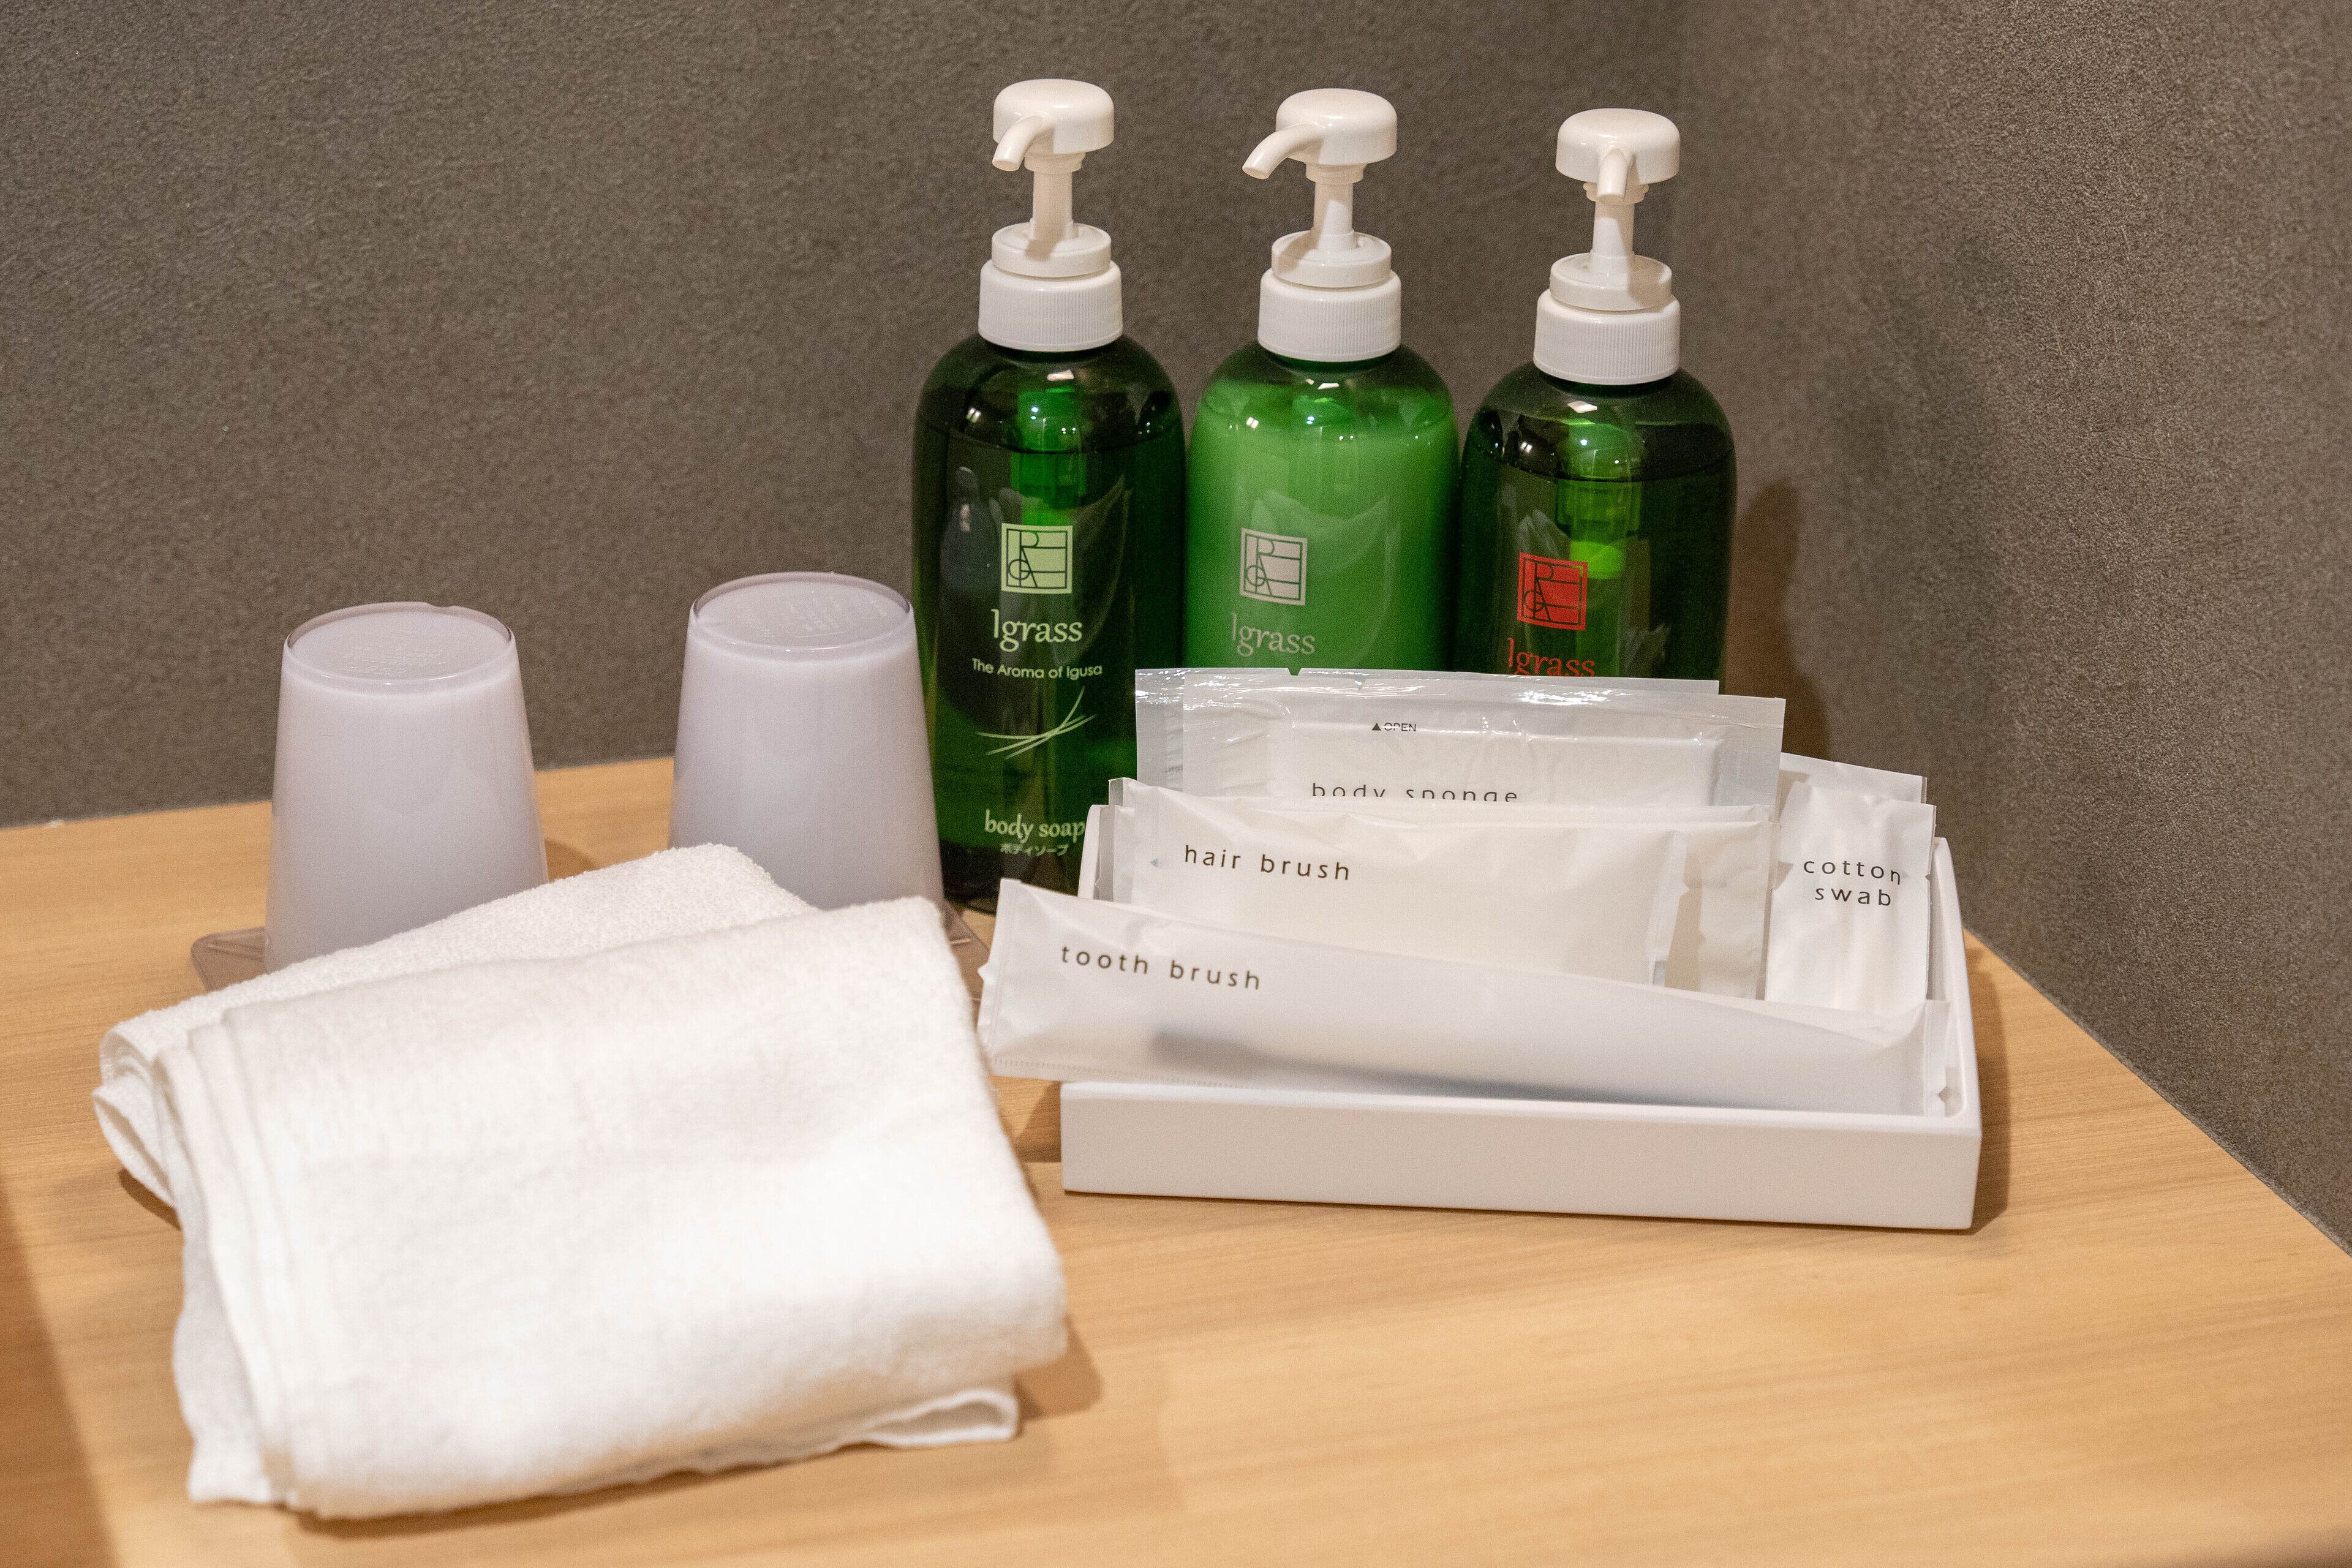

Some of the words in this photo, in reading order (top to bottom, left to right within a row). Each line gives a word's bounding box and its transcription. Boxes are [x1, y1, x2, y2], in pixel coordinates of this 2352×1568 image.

[972, 657, 994, 674] The
[997, 664, 1045, 679] Aroma
[1048, 666, 1063, 678] of
[1066, 665, 1103, 680] Igusa
[1384, 722, 1417, 732] OPEN
[984, 809, 1034, 844] body
[1039, 821, 1086, 843] soap
[1185, 844, 1241, 869] hair
[1260, 853, 1349, 881] brush
[1803, 860, 1901, 886] cotton
[1814, 888, 1892, 907] swab
[1061, 946, 1149, 975] tooth
[1170, 959, 1261, 990] brush
